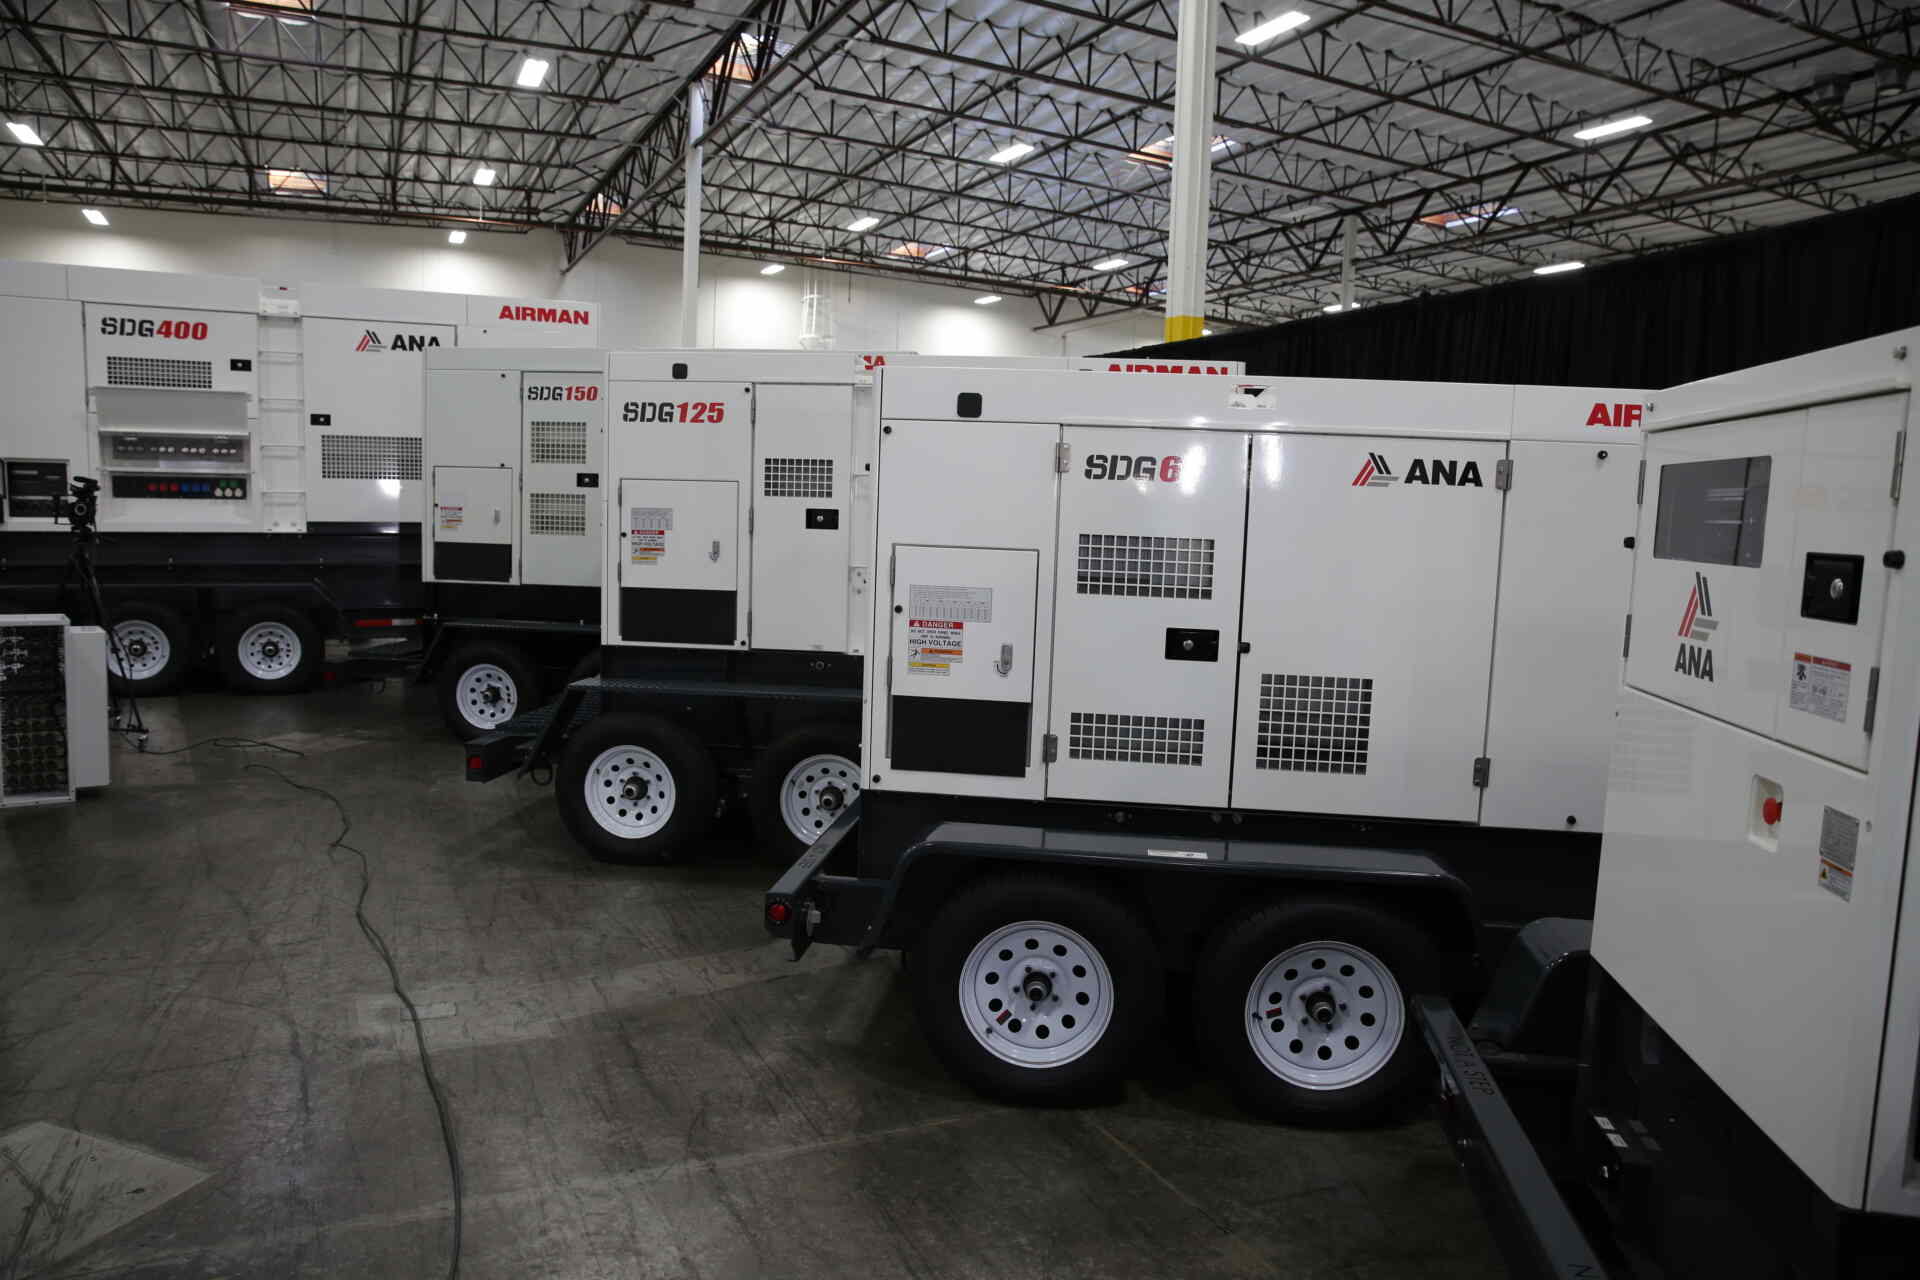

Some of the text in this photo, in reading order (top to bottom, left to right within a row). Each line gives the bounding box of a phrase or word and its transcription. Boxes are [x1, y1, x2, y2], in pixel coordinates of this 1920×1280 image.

[498, 305, 590, 325] AIRMAN
[101, 317, 209, 341] SDG400
[391, 334, 440, 352] ANA
[527, 386, 599, 401] SDG150
[622, 401, 725, 424] SDG125
[1404, 458, 1484, 488] ANA
[1674, 642, 1714, 682] ANA
